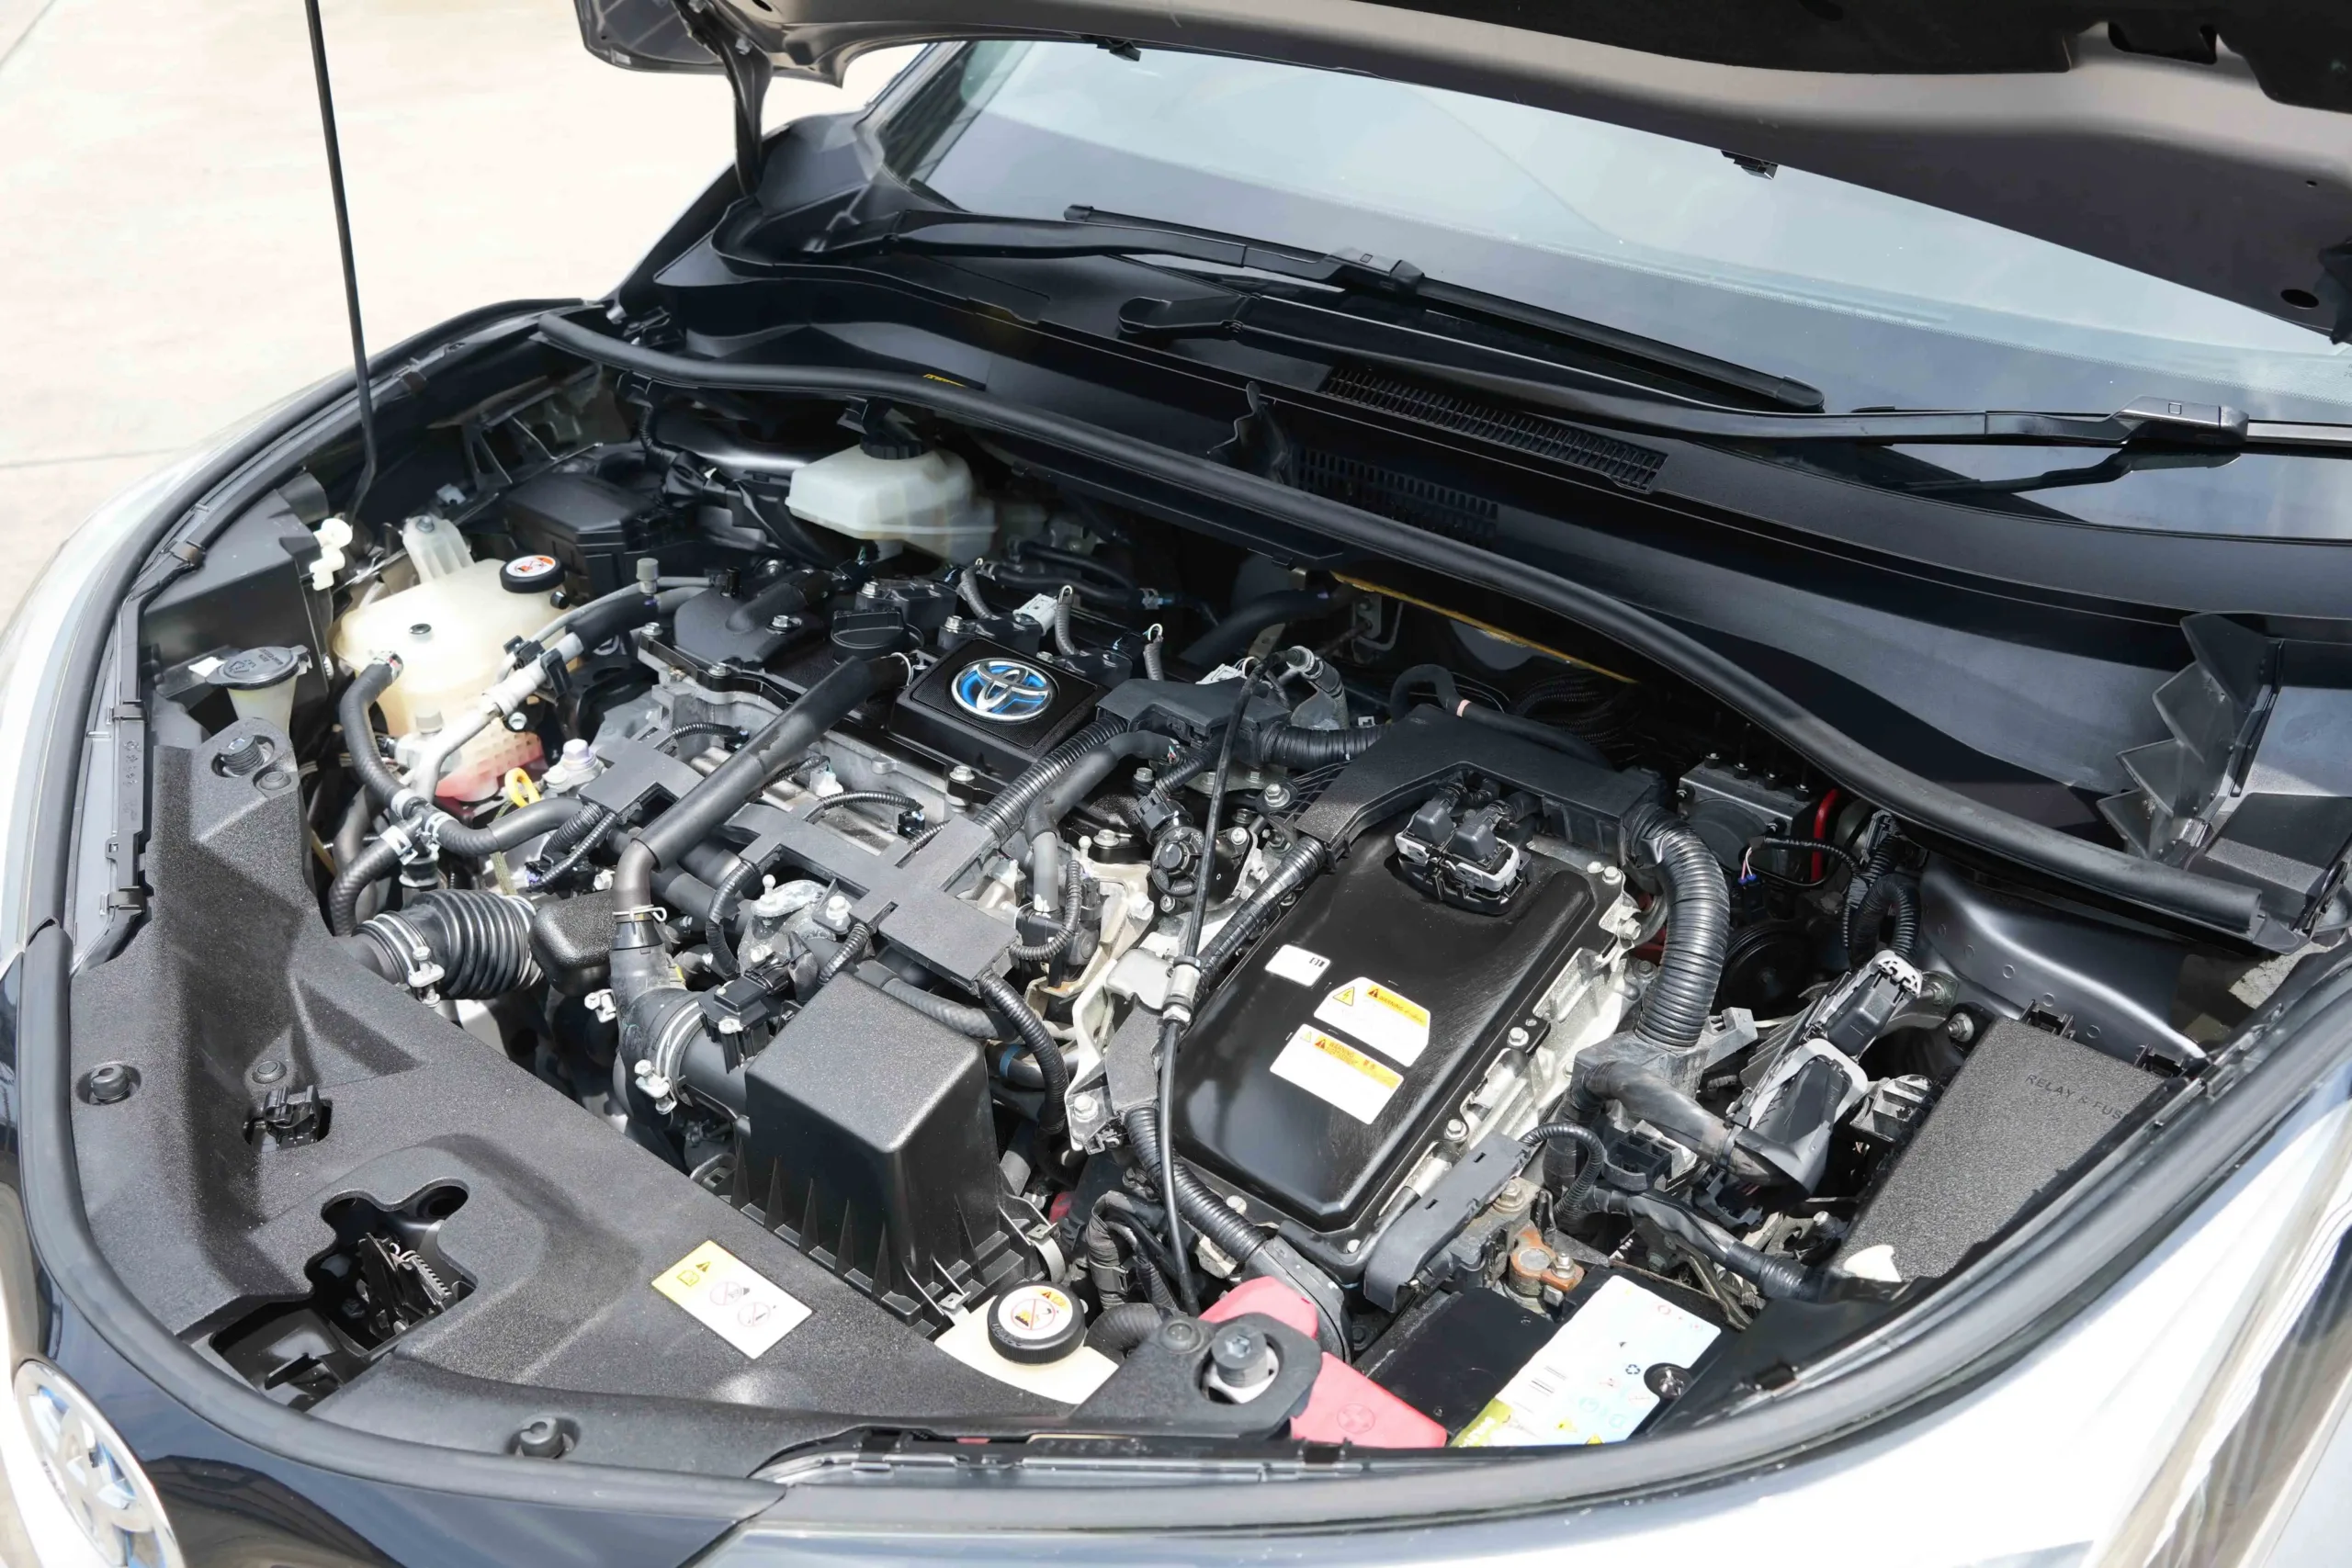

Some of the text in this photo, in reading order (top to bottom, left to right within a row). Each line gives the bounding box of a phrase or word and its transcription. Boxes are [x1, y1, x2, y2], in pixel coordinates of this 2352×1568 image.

[1173, 884, 1193, 892] TOYOTA
[1378, 995, 1405, 1011] WARNING
[1329, 1042, 1355, 1058] WARNING
[2024, 1073, 2075, 1100] RELAY
